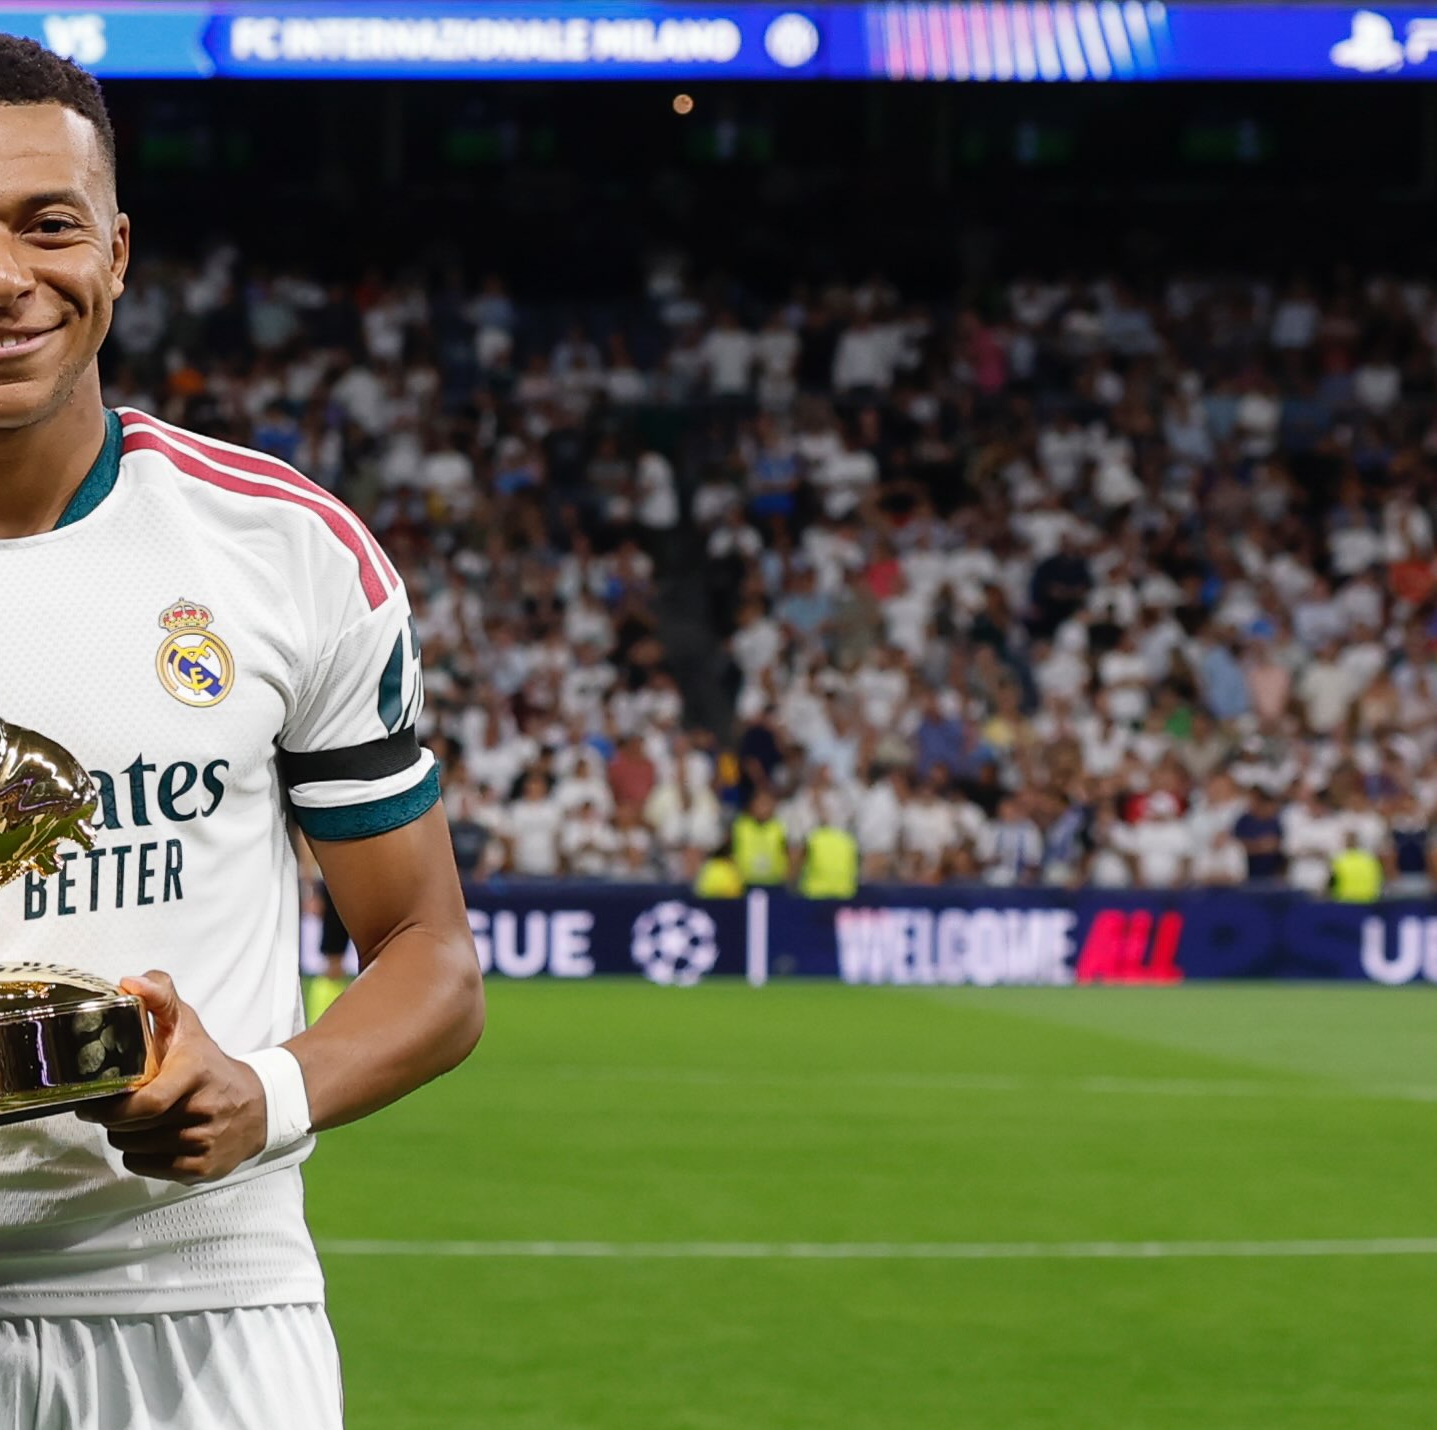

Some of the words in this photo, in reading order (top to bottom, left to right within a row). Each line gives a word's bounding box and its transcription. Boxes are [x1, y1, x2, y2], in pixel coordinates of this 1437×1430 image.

[43, 13, 106, 64] VS
[231, 16, 281, 61] FC
[282, 16, 589, 62] INTERNAZIONALE
[591, 17, 742, 63] MILANO
[24, 838, 184, 921] BETTER
[835, 908, 1077, 986] WELCOME
[1075, 909, 1184, 987] ALL
